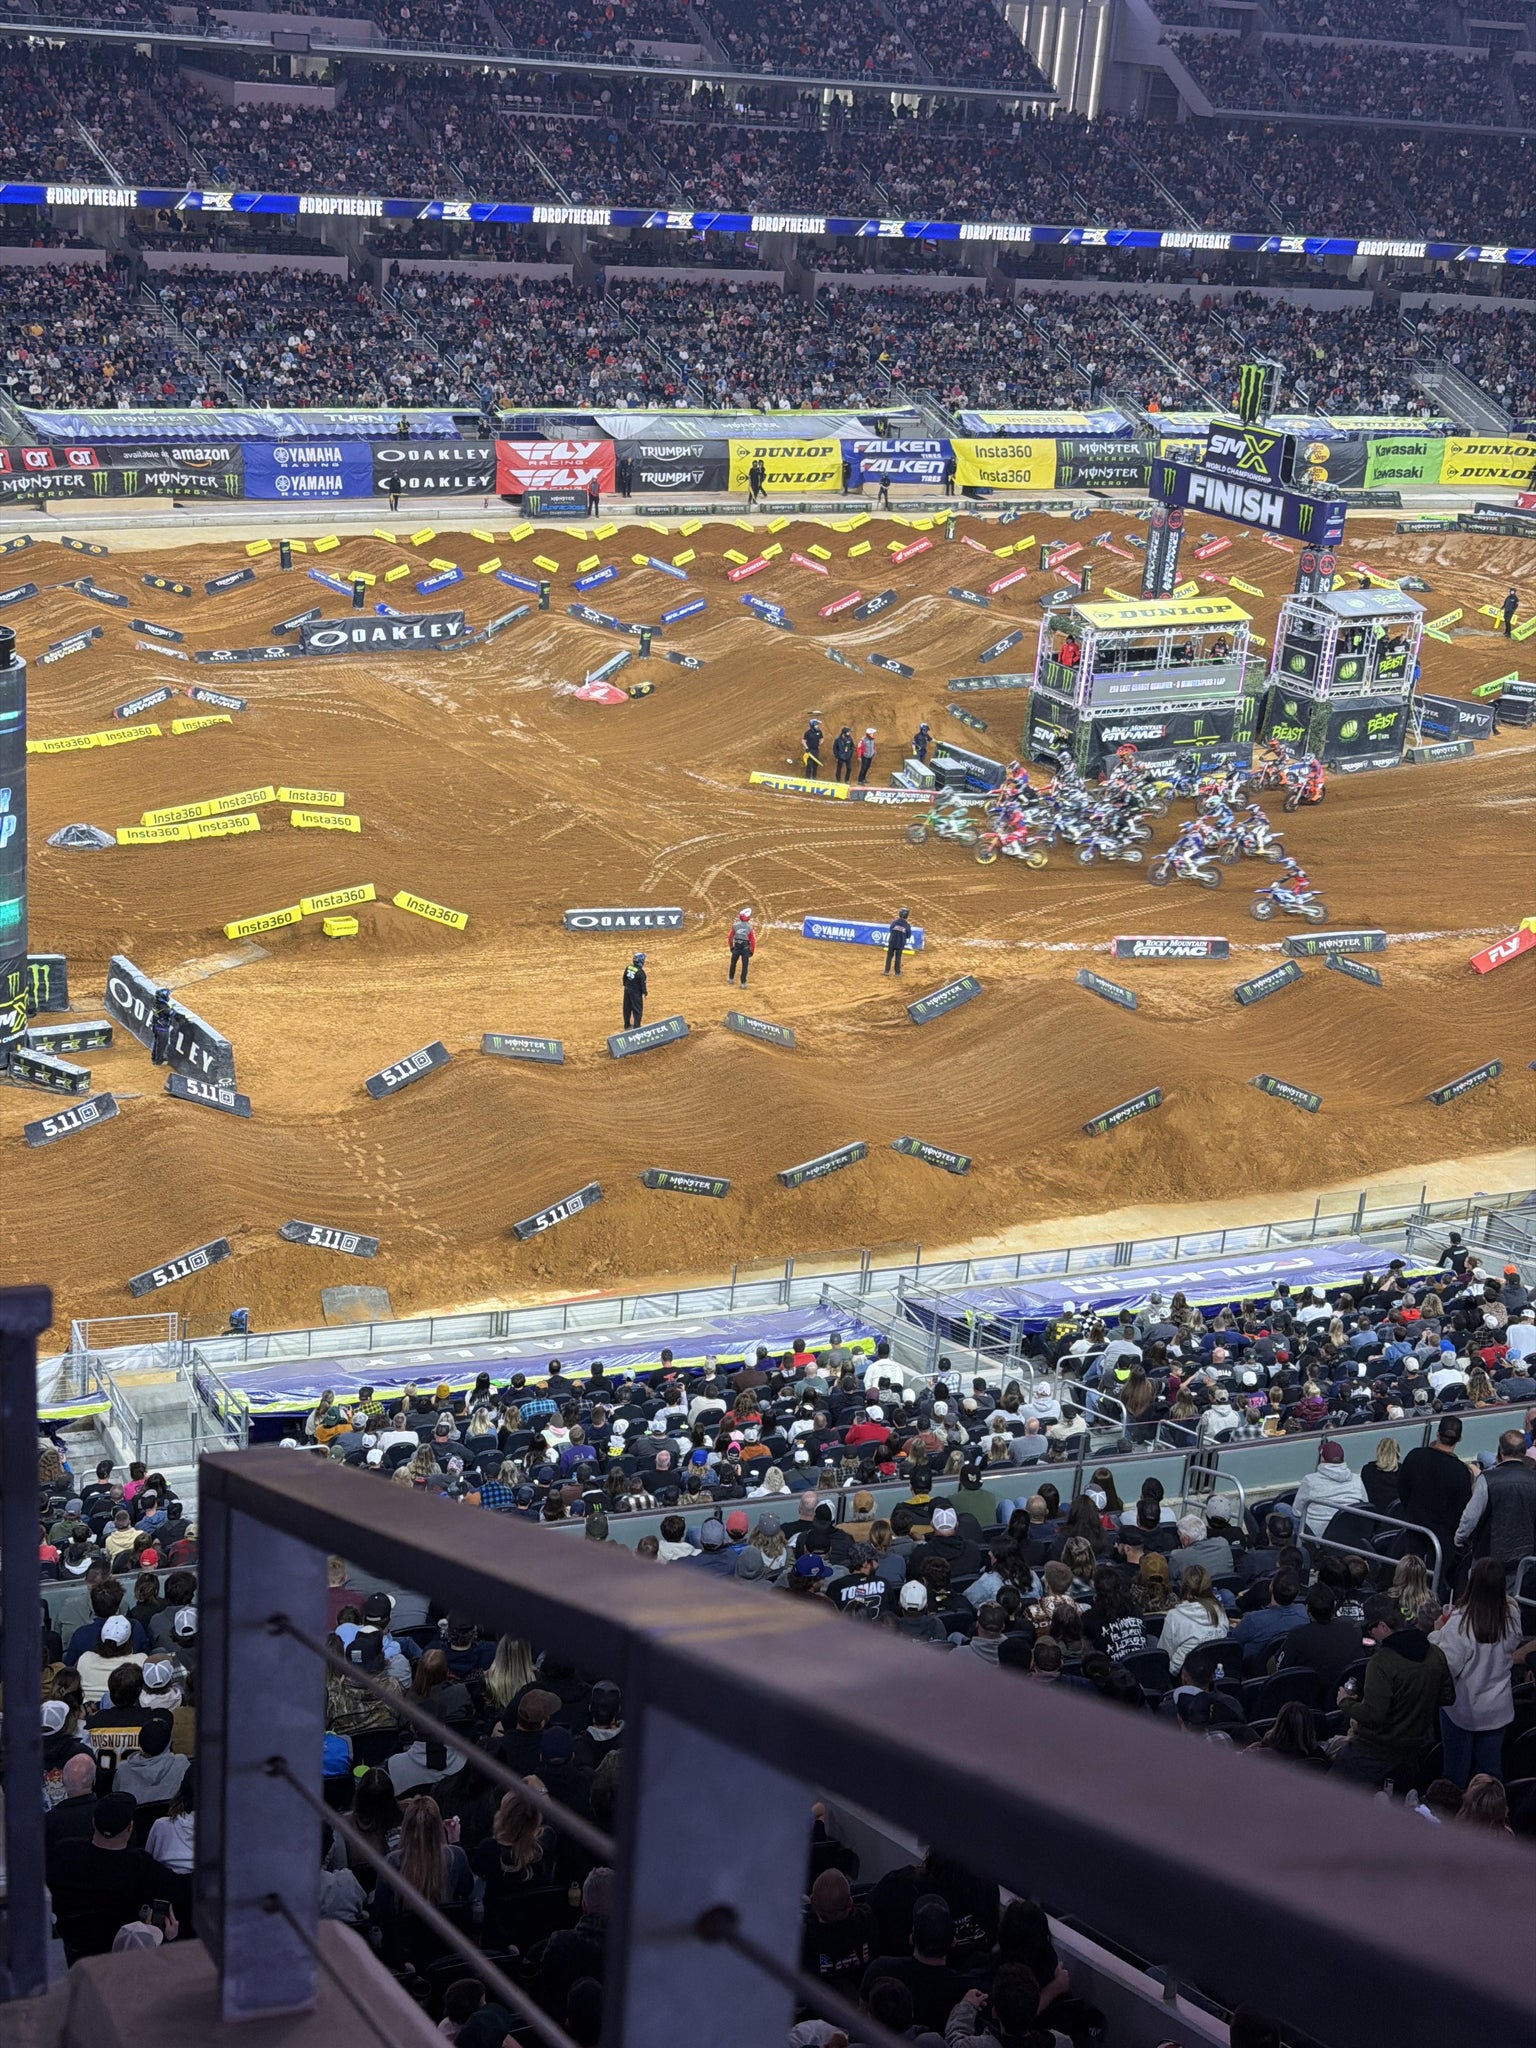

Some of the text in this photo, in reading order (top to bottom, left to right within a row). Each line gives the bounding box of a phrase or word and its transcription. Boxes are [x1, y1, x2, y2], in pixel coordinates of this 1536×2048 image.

[46, 187, 137, 207] #DROPTHEGATE
[299, 197, 383, 217] #DROPTHEGATE
[532, 206, 611, 225] #DROPTHEGATE
[751, 215, 826, 234] #DROPTHEGATE
[959, 224, 1031, 242] #DROPTHEGATE
[1160, 232, 1231, 250] #DROPTHEGATE
[1356, 240, 1427, 258] #DROPTHEGATE
[123, 450, 160, 459] available
[172, 448, 230, 461] amazon
[289, 447, 342, 462] YAMAHA
[409, 449, 490, 461] OAKLEY
[508, 442, 602, 460] FLY
[640, 446, 691, 459] TRIUMPH
[753, 446, 834, 458] DUNLOP
[853, 441, 940, 453] FALKEN
[975, 445, 1032, 458] Insta360
[1079, 441, 1140, 455] MONSTER
[1208, 433, 1275, 474] SMX
[1375, 443, 1428, 456] Kawasaki
[25, 451, 49, 467] QT
[69, 450, 92, 466] QT
[860, 458, 944, 473] FALKEN
[145, 470, 219, 488] MONSTER
[509, 468, 603, 487] FLY
[640, 472, 691, 485] TRIUMPH
[764, 472, 835, 483] UNLOP
[921, 475, 941, 483] TIRES
[979, 469, 1031, 483] Insta360
[1078, 466, 1138, 478] MONSTER
[1205, 461, 1272, 484] WORLD CHAMPIONSHIP
[1373, 466, 1424, 480] Kawasaki
[3, 472, 86, 492] MONSTER
[290, 475, 343, 490] YAMAHA
[409, 476, 491, 488] OAKLEY
[17, 490, 74, 500] ENERGY
[157, 488, 209, 496] ENERGY
[1188, 473, 1284, 528] FINISH
[903, 540, 930, 557] HONDA
[999, 571, 1027, 589] HONDA
[1175, 586, 1196, 597] ZUKI
[834, 596, 861, 613] HONDA
[1118, 604, 1233, 619] DUNLOP
[1429, 612, 1460, 630] SUZUKI
[352, 623, 463, 643] OAKLEY
[1379, 655, 1406, 673] BEAST
[182, 718, 225, 731] Insta360
[1367, 713, 1399, 734] BEAST
[106, 727, 153, 741] Insta360
[1271, 725, 1305, 742] BEAST
[43, 737, 91, 750] Insta360
[1432, 746, 1459, 755] MONSTER
[219, 790, 267, 810] Insta360
[288, 790, 337, 803] Insta360
[875, 791, 931, 800] ROCKY MOUNTAIN
[153, 806, 203, 824] Insta360
[302, 813, 352, 827] Insta360
[127, 827, 180, 839] Insta360
[199, 817, 250, 833] Insta360
[311, 888, 366, 910] Insta360
[406, 897, 460, 924] Insta360
[237, 912, 293, 936] Insta360
[601, 914, 680, 926] OAKLEY
[822, 925, 856, 938] YAMAHA
[1319, 938, 1360, 949] MONSTER
[1488, 937, 1521, 963] FLY
[1344, 957, 1370, 975] MONSTER
[1095, 977, 1125, 995] MONSTER
[1252, 968, 1286, 989] MONSTER
[926, 985, 962, 1006] MONSTER
[628, 1025, 669, 1043] MONSTER
[747, 1018, 781, 1035] MONSTER
[134, 999, 215, 1074] OALEY
[505, 1038, 546, 1050] MONSTER
[381, 1061, 417, 1087] 5.11
[1453, 1071, 1488, 1093] MONSTER
[186, 1080, 219, 1102] 5.11
[1276, 1083, 1309, 1101] MONSTER
[1109, 1101, 1147, 1122] MONSTER
[42, 1111, 82, 1137] 5.11
[921, 1144, 956, 1164] MONSTER
[806, 1155, 848, 1178] MONSTER
[670, 1176, 711, 1190] MONSTER
[536, 1206, 569, 1231] 5.11
[308, 1226, 341, 1250] 5.11
[152, 1259, 191, 1288] 5.11
[1069, 1257, 1314, 1294] FALKEN
[840, 1580, 885, 1602] TOMAC
[1101, 1626, 1109, 1637] A
[1106, 1644, 1114, 1655] A
[91, 1734, 141, 1749] HUSNUTDI
